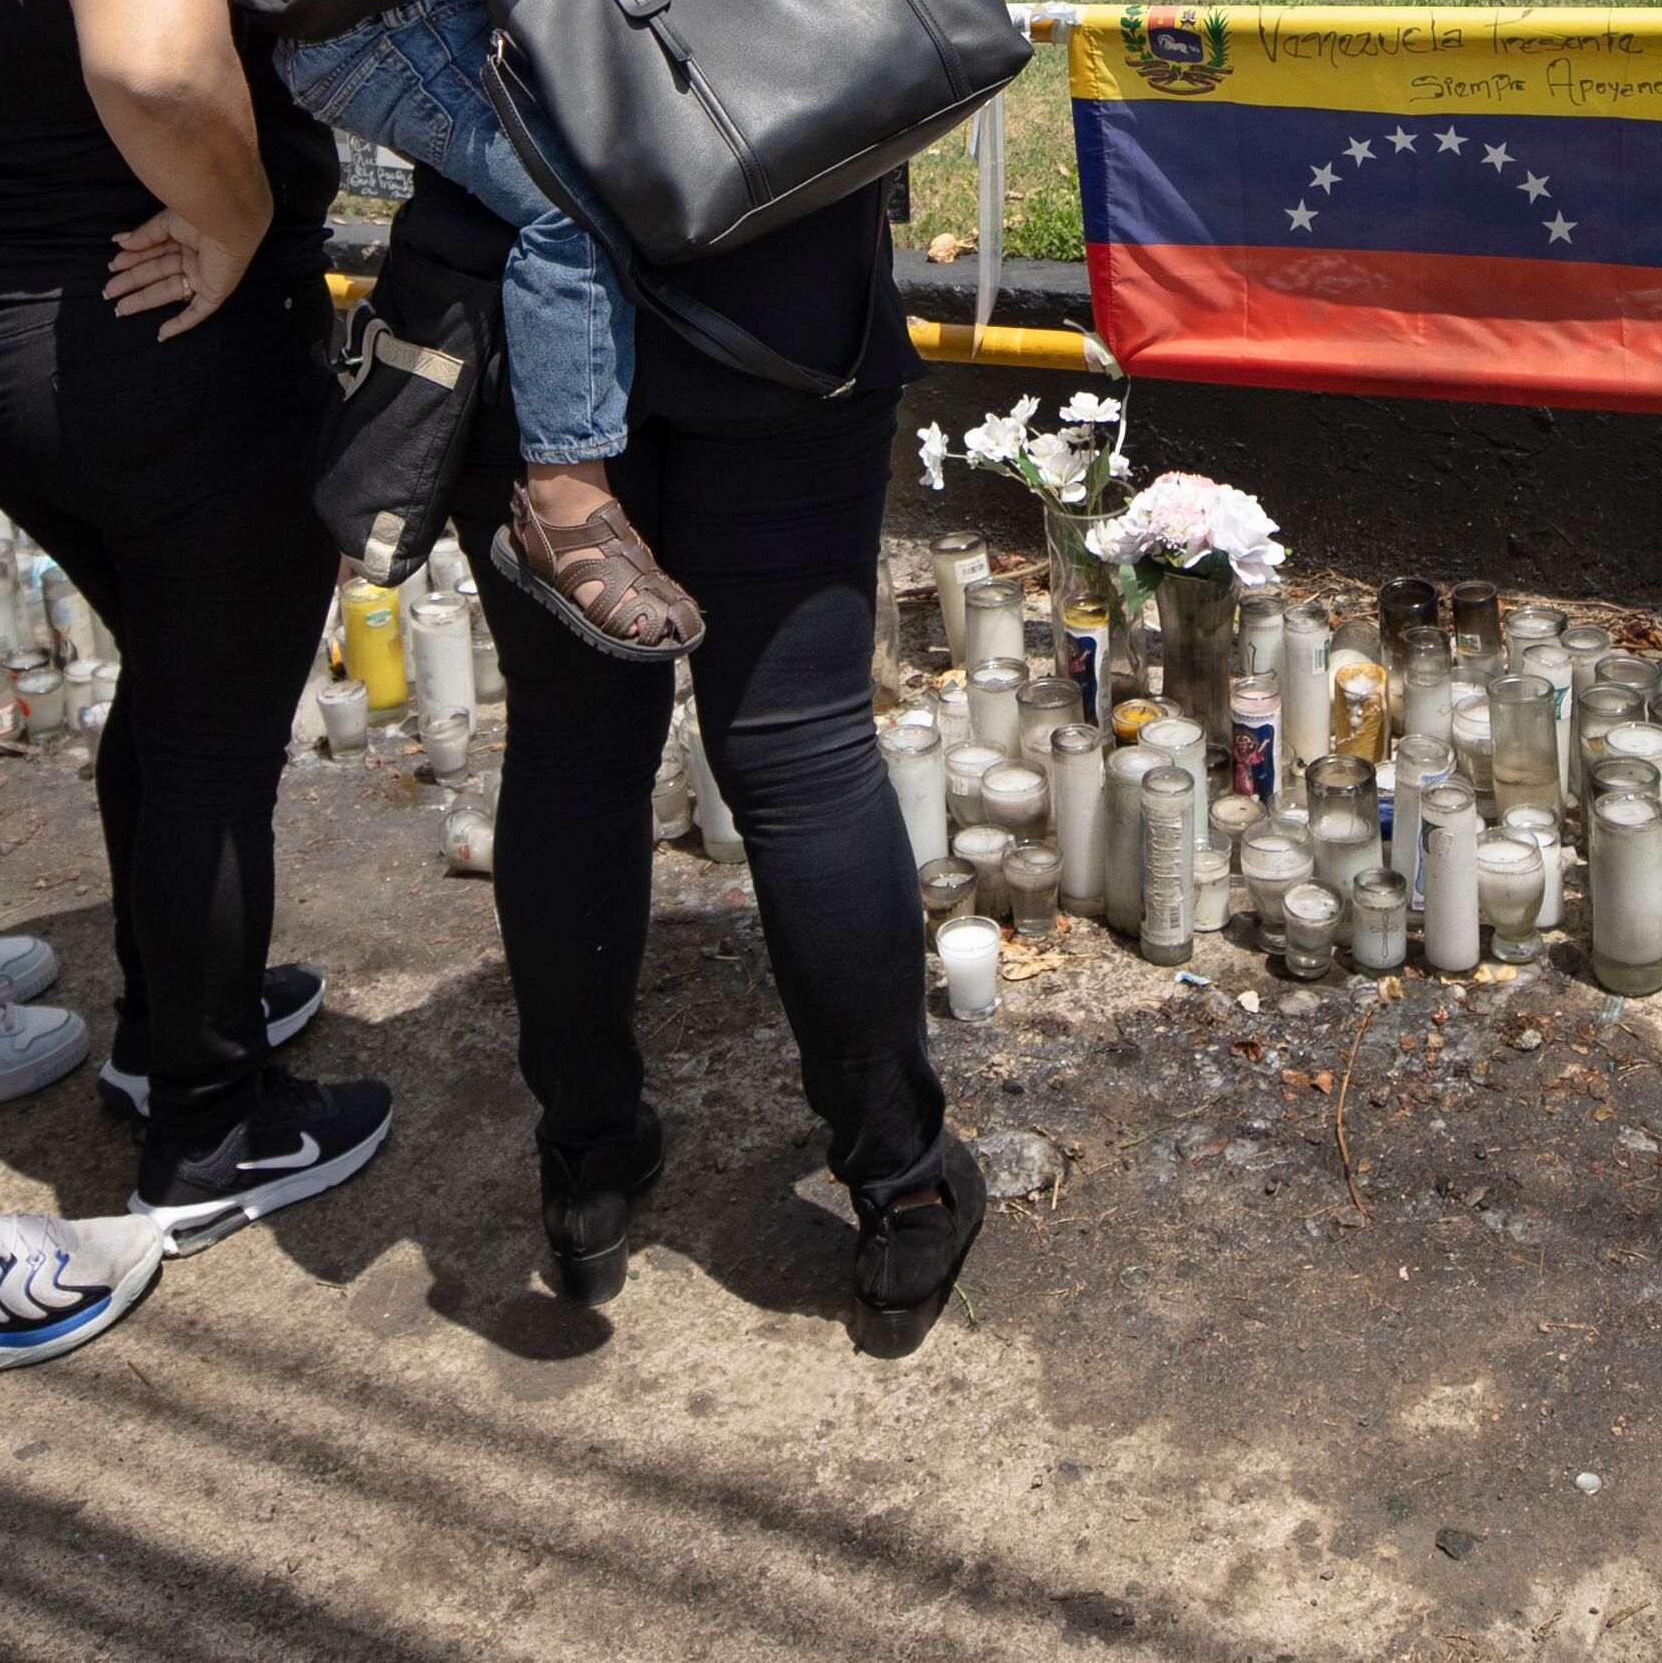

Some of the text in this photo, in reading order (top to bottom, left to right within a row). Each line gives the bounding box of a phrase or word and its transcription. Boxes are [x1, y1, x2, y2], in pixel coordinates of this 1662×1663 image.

[1257, 6, 1644, 68] Venezuela Presente
[1410, 73, 1525, 103] Siempre
